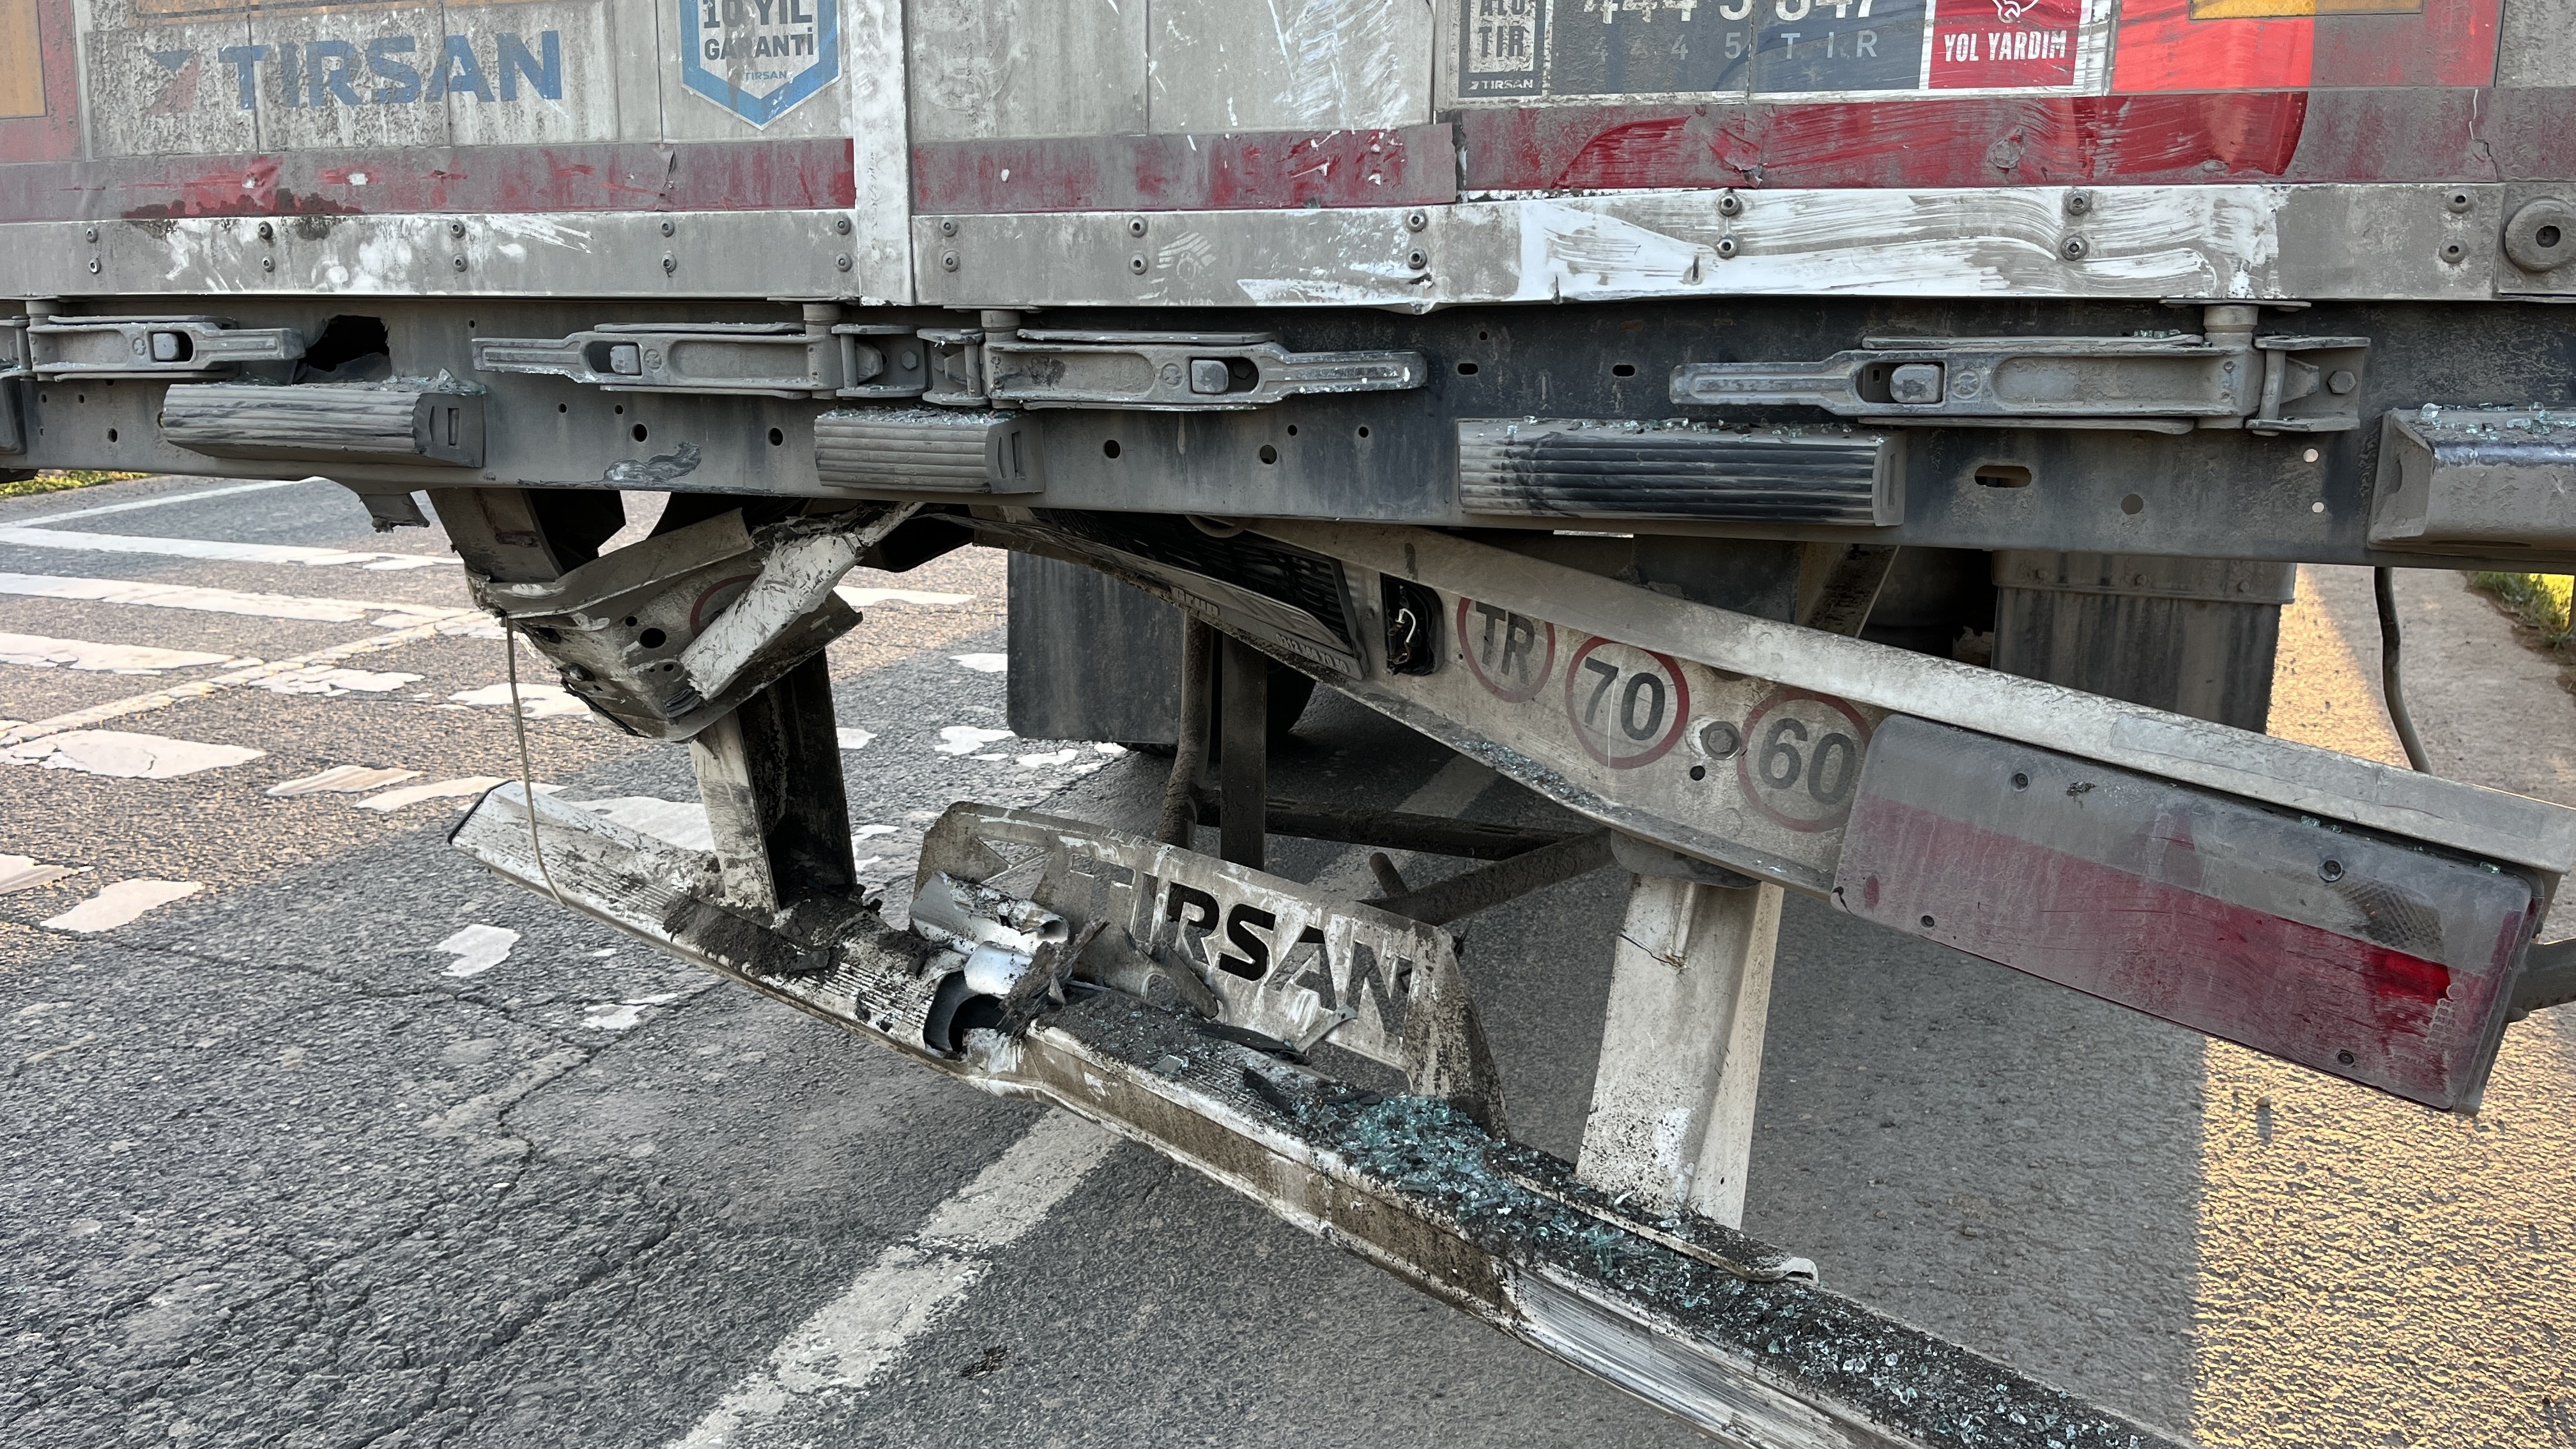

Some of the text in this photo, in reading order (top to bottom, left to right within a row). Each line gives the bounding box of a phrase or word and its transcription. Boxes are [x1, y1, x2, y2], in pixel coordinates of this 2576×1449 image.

[704, 27, 813, 61] GARANTİ
[1478, 26, 1524, 57] TIR
[1944, 30, 2067, 62] YOL YARDIM
[217, 31, 562, 111] TIRSAN
[745, 70, 787, 81] TIRSAN
[1481, 79, 1533, 89] TIRSAN
[1475, 602, 1534, 687] TR
[1584, 657, 1666, 741] 70
[1758, 717, 1854, 806] 60
